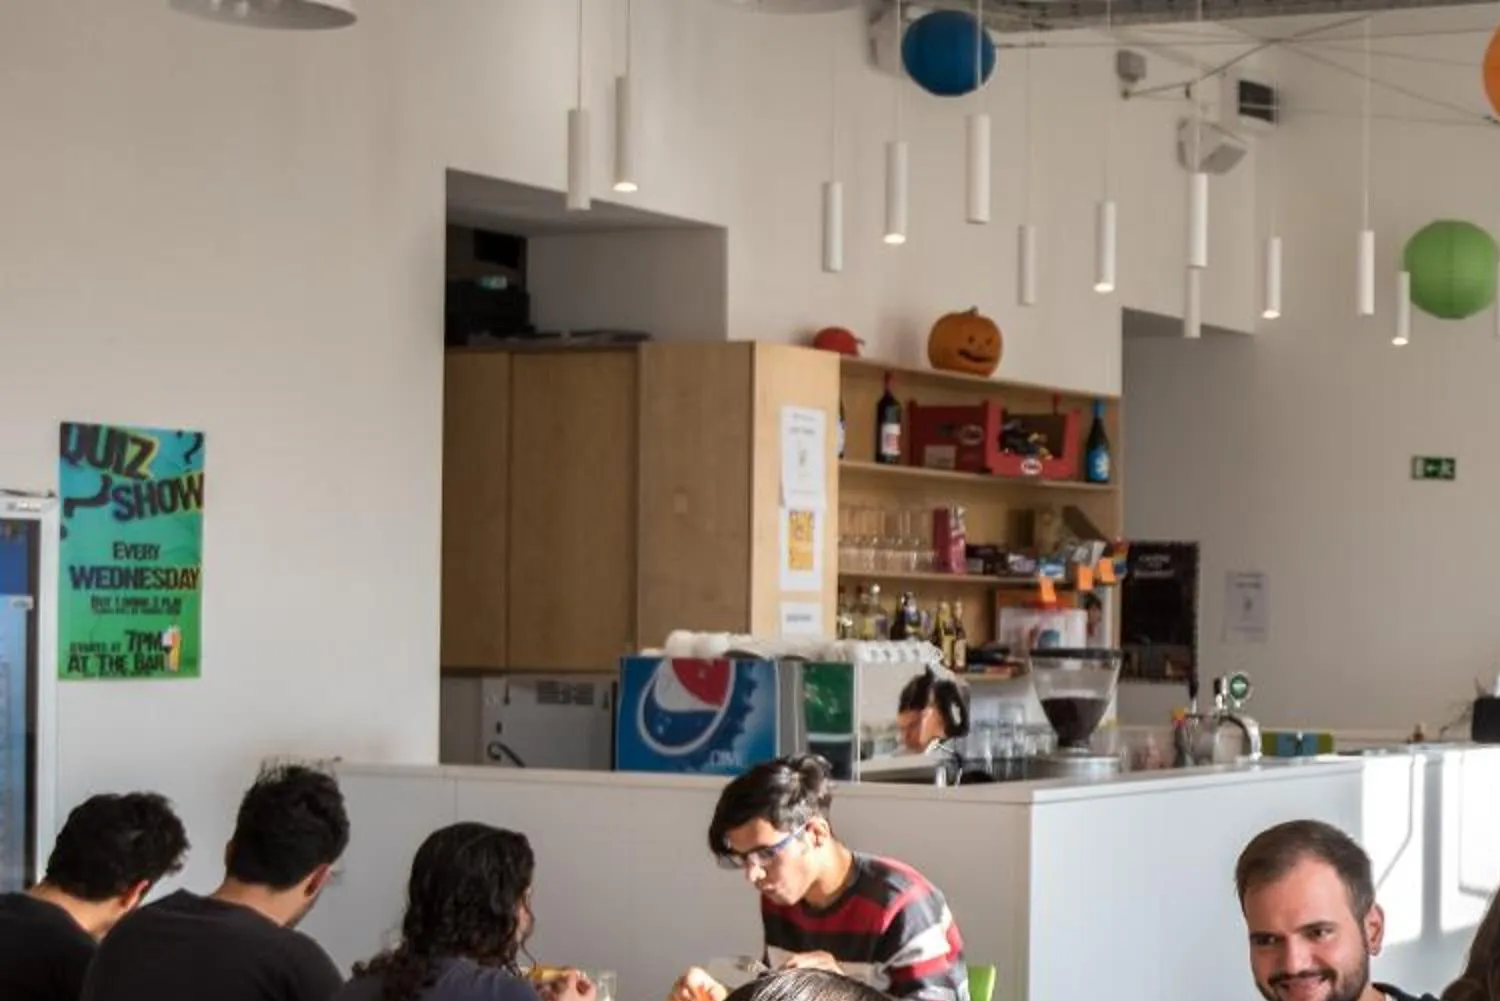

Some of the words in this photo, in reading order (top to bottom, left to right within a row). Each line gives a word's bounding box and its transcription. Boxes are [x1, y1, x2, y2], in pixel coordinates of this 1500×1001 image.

[61, 422, 155, 481] QUIZ
[112, 472, 204, 522] SHOW
[113, 542, 161, 561] EVERY
[69, 564, 201, 590] WEDNESDAY
[67, 653, 89, 673] AT
[95, 653, 128, 674] THE
